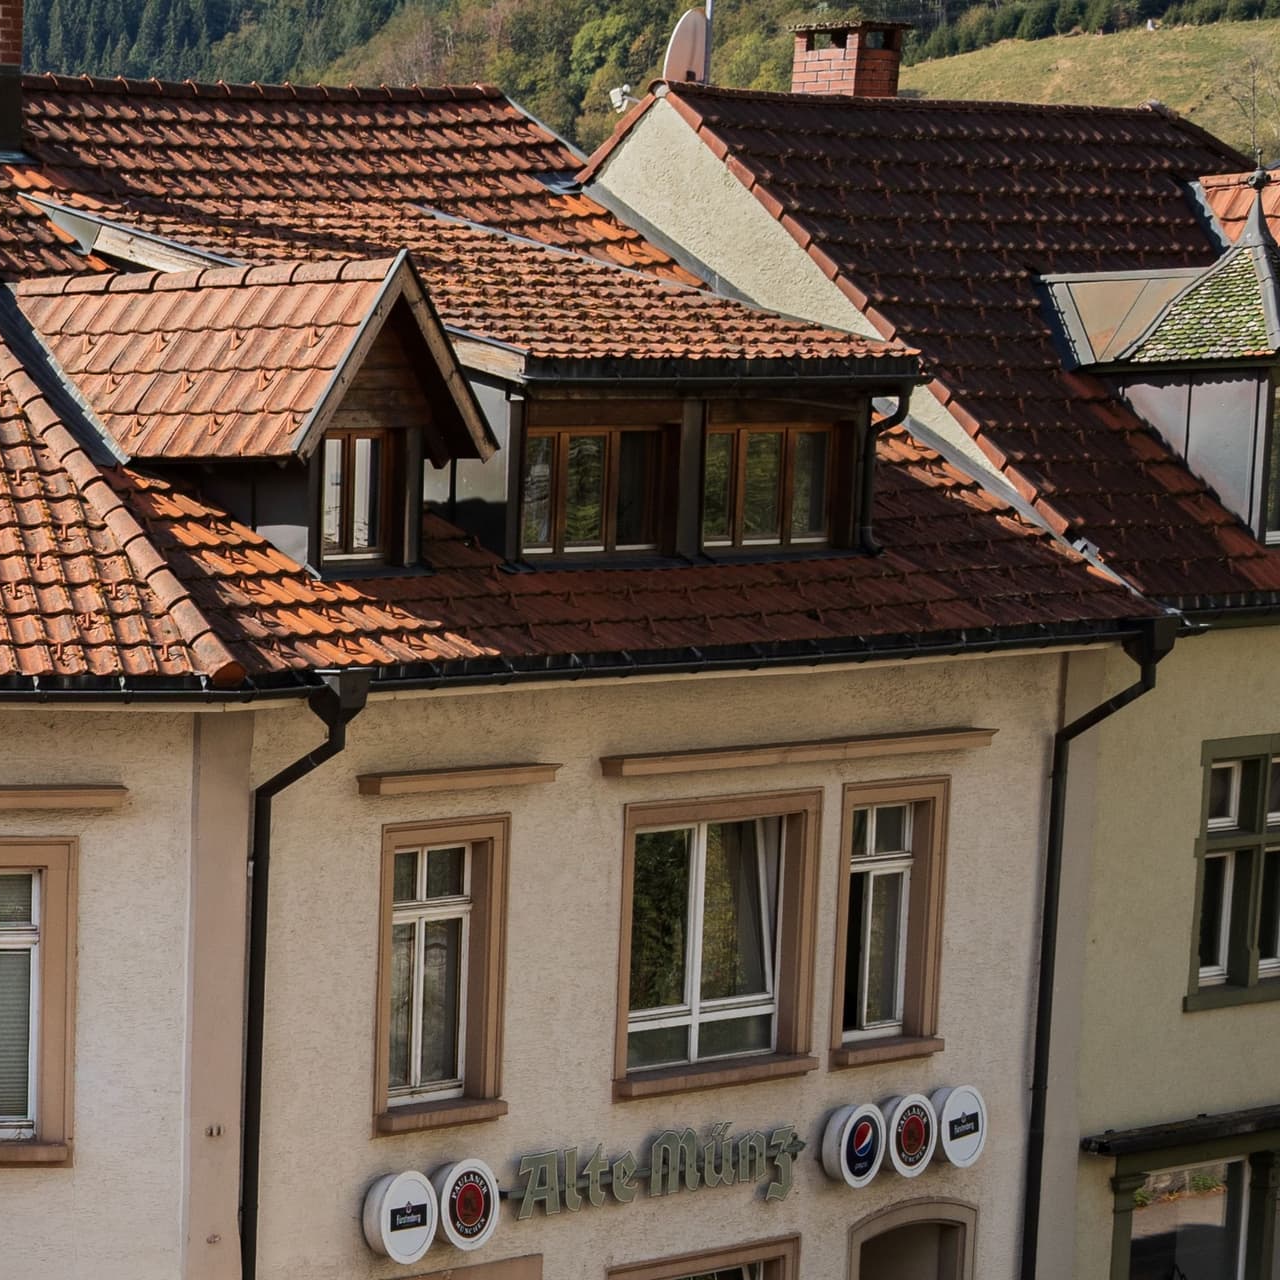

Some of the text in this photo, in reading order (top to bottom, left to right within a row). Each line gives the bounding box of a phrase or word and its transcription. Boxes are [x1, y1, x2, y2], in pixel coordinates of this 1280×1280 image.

[451, 1173, 488, 1200] PAULANER
[517, 1121, 795, 1220] Alte Münz
